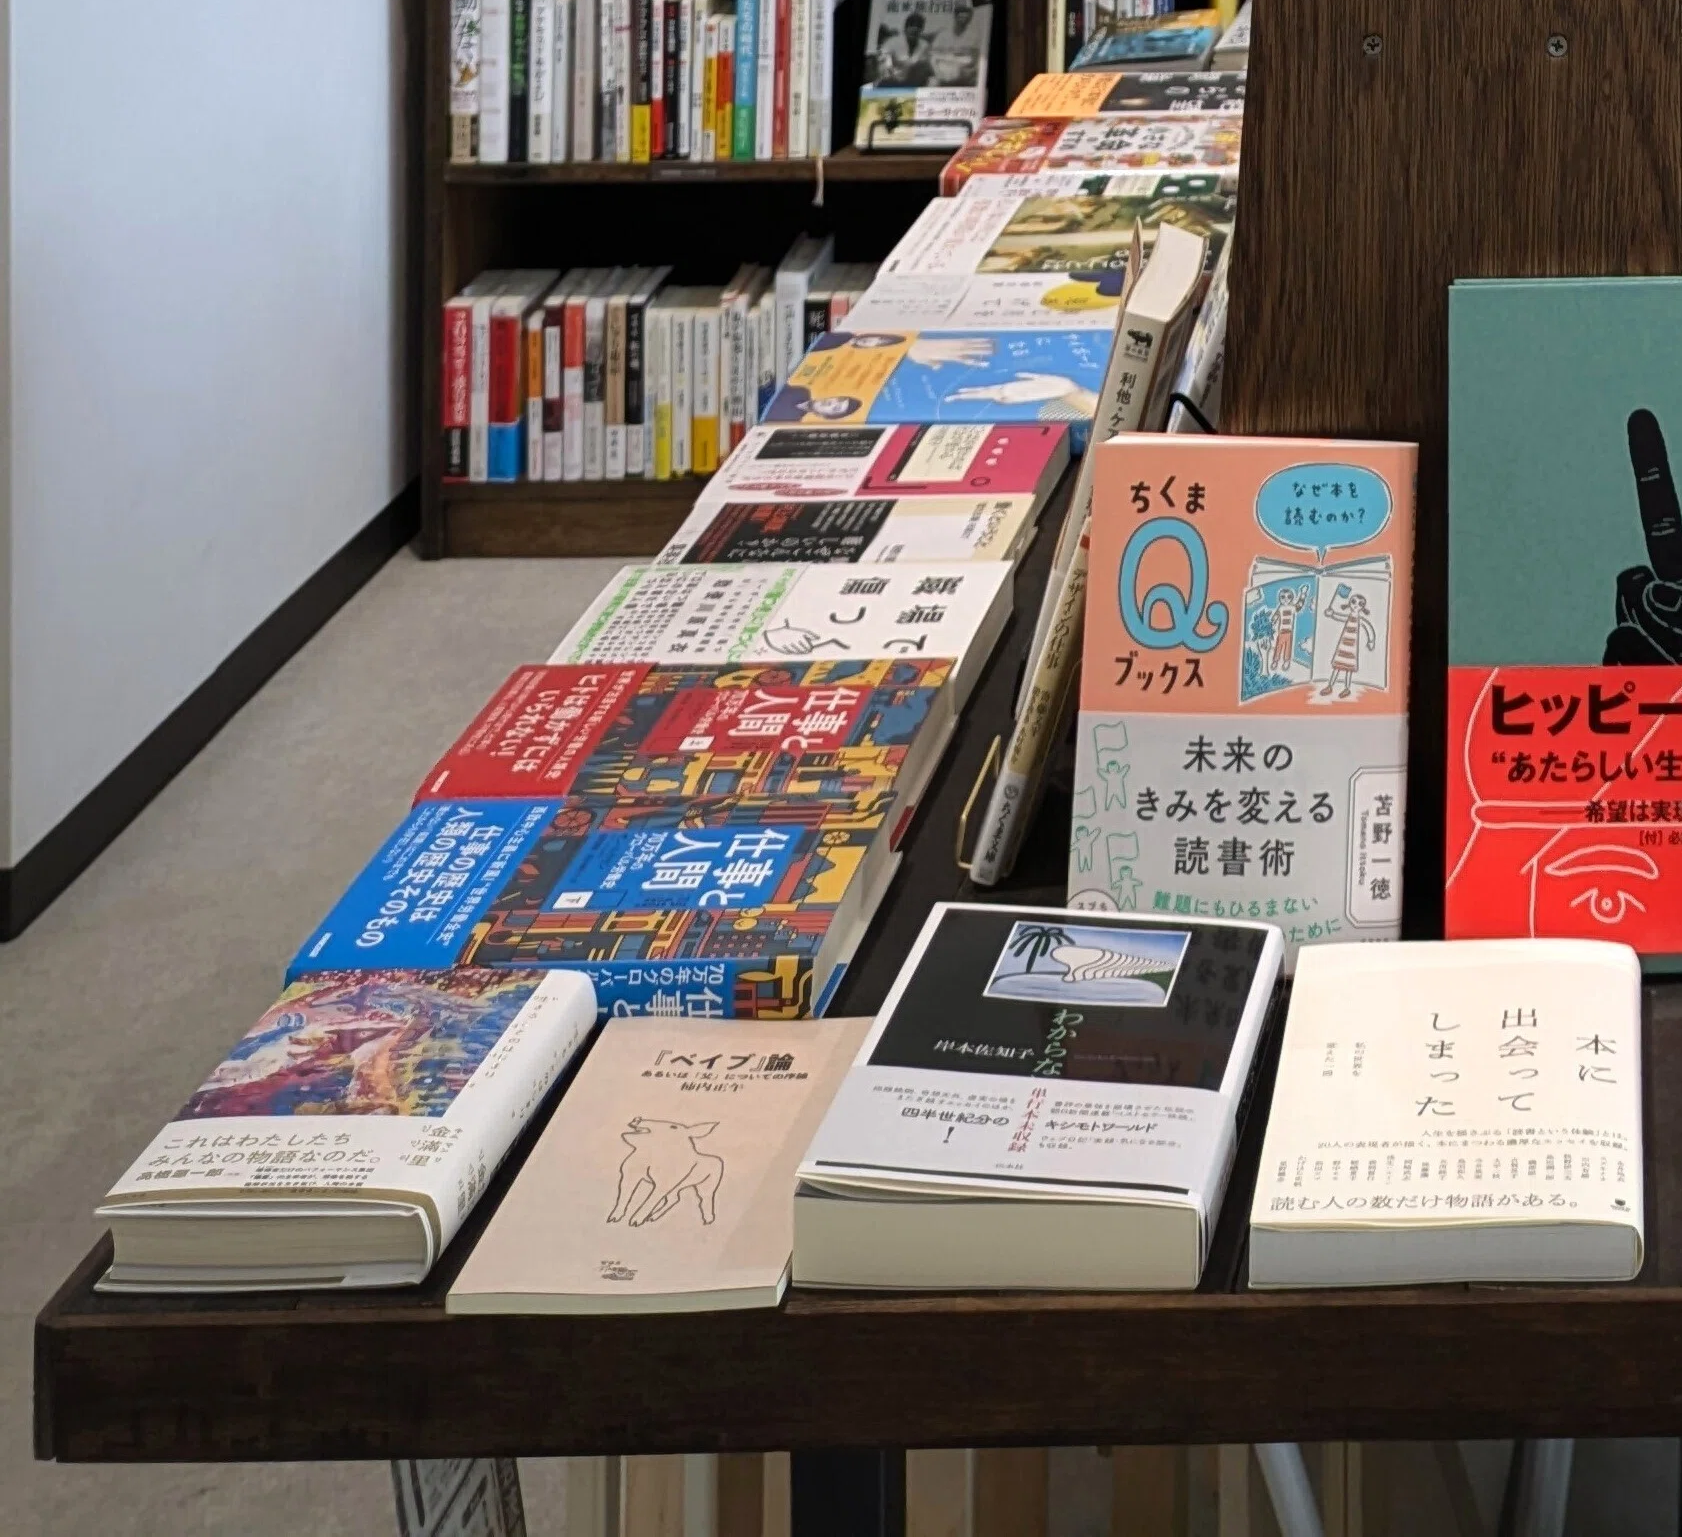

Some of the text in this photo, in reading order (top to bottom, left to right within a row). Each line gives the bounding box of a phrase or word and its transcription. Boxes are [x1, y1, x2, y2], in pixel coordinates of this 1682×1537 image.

[1130, 476, 1206, 514] ちくま
[1292, 481, 1359, 499] なぜ本を
[1118, 516, 1229, 653] Q
[1115, 651, 1206, 694] ブックス
[507, 674, 608, 772] ヒトは働かずには
[724, 688, 805, 736] 人間
[775, 686, 864, 750] 仕事と
[1183, 734, 1293, 774] 未来の
[1135, 787, 1335, 824] きみを変える
[636, 830, 730, 890] 人間
[690, 827, 797, 906] 仕事と
[1173, 836, 1297, 878] 読書術
[1370, 795, 1394, 901] 苫野一徳
[348, 806, 486, 947] 人類の歴史そのもの
[401, 824, 506, 922] 仕事の歴史は
[1152, 890, 1318, 917] 難題にもひるまない
[654, 1050, 795, 1072] 『ベイブ』論
[1030, 1008, 1084, 1077] わからな
[1415, 1012, 1462, 1117] しまった
[1498, 1008, 1540, 1112] 出会って
[1576, 1034, 1618, 1084] 本に
[901, 1107, 1010, 1126] 四半世紀分の
[1045, 1120, 1158, 1133] キシモトワールド
[149, 1150, 382, 1166] みんなの物語なのだ。
[164, 1134, 353, 1149] これはわたしたち
[1270, 1193, 1579, 1211] 読む人の数だけ物語がある。
